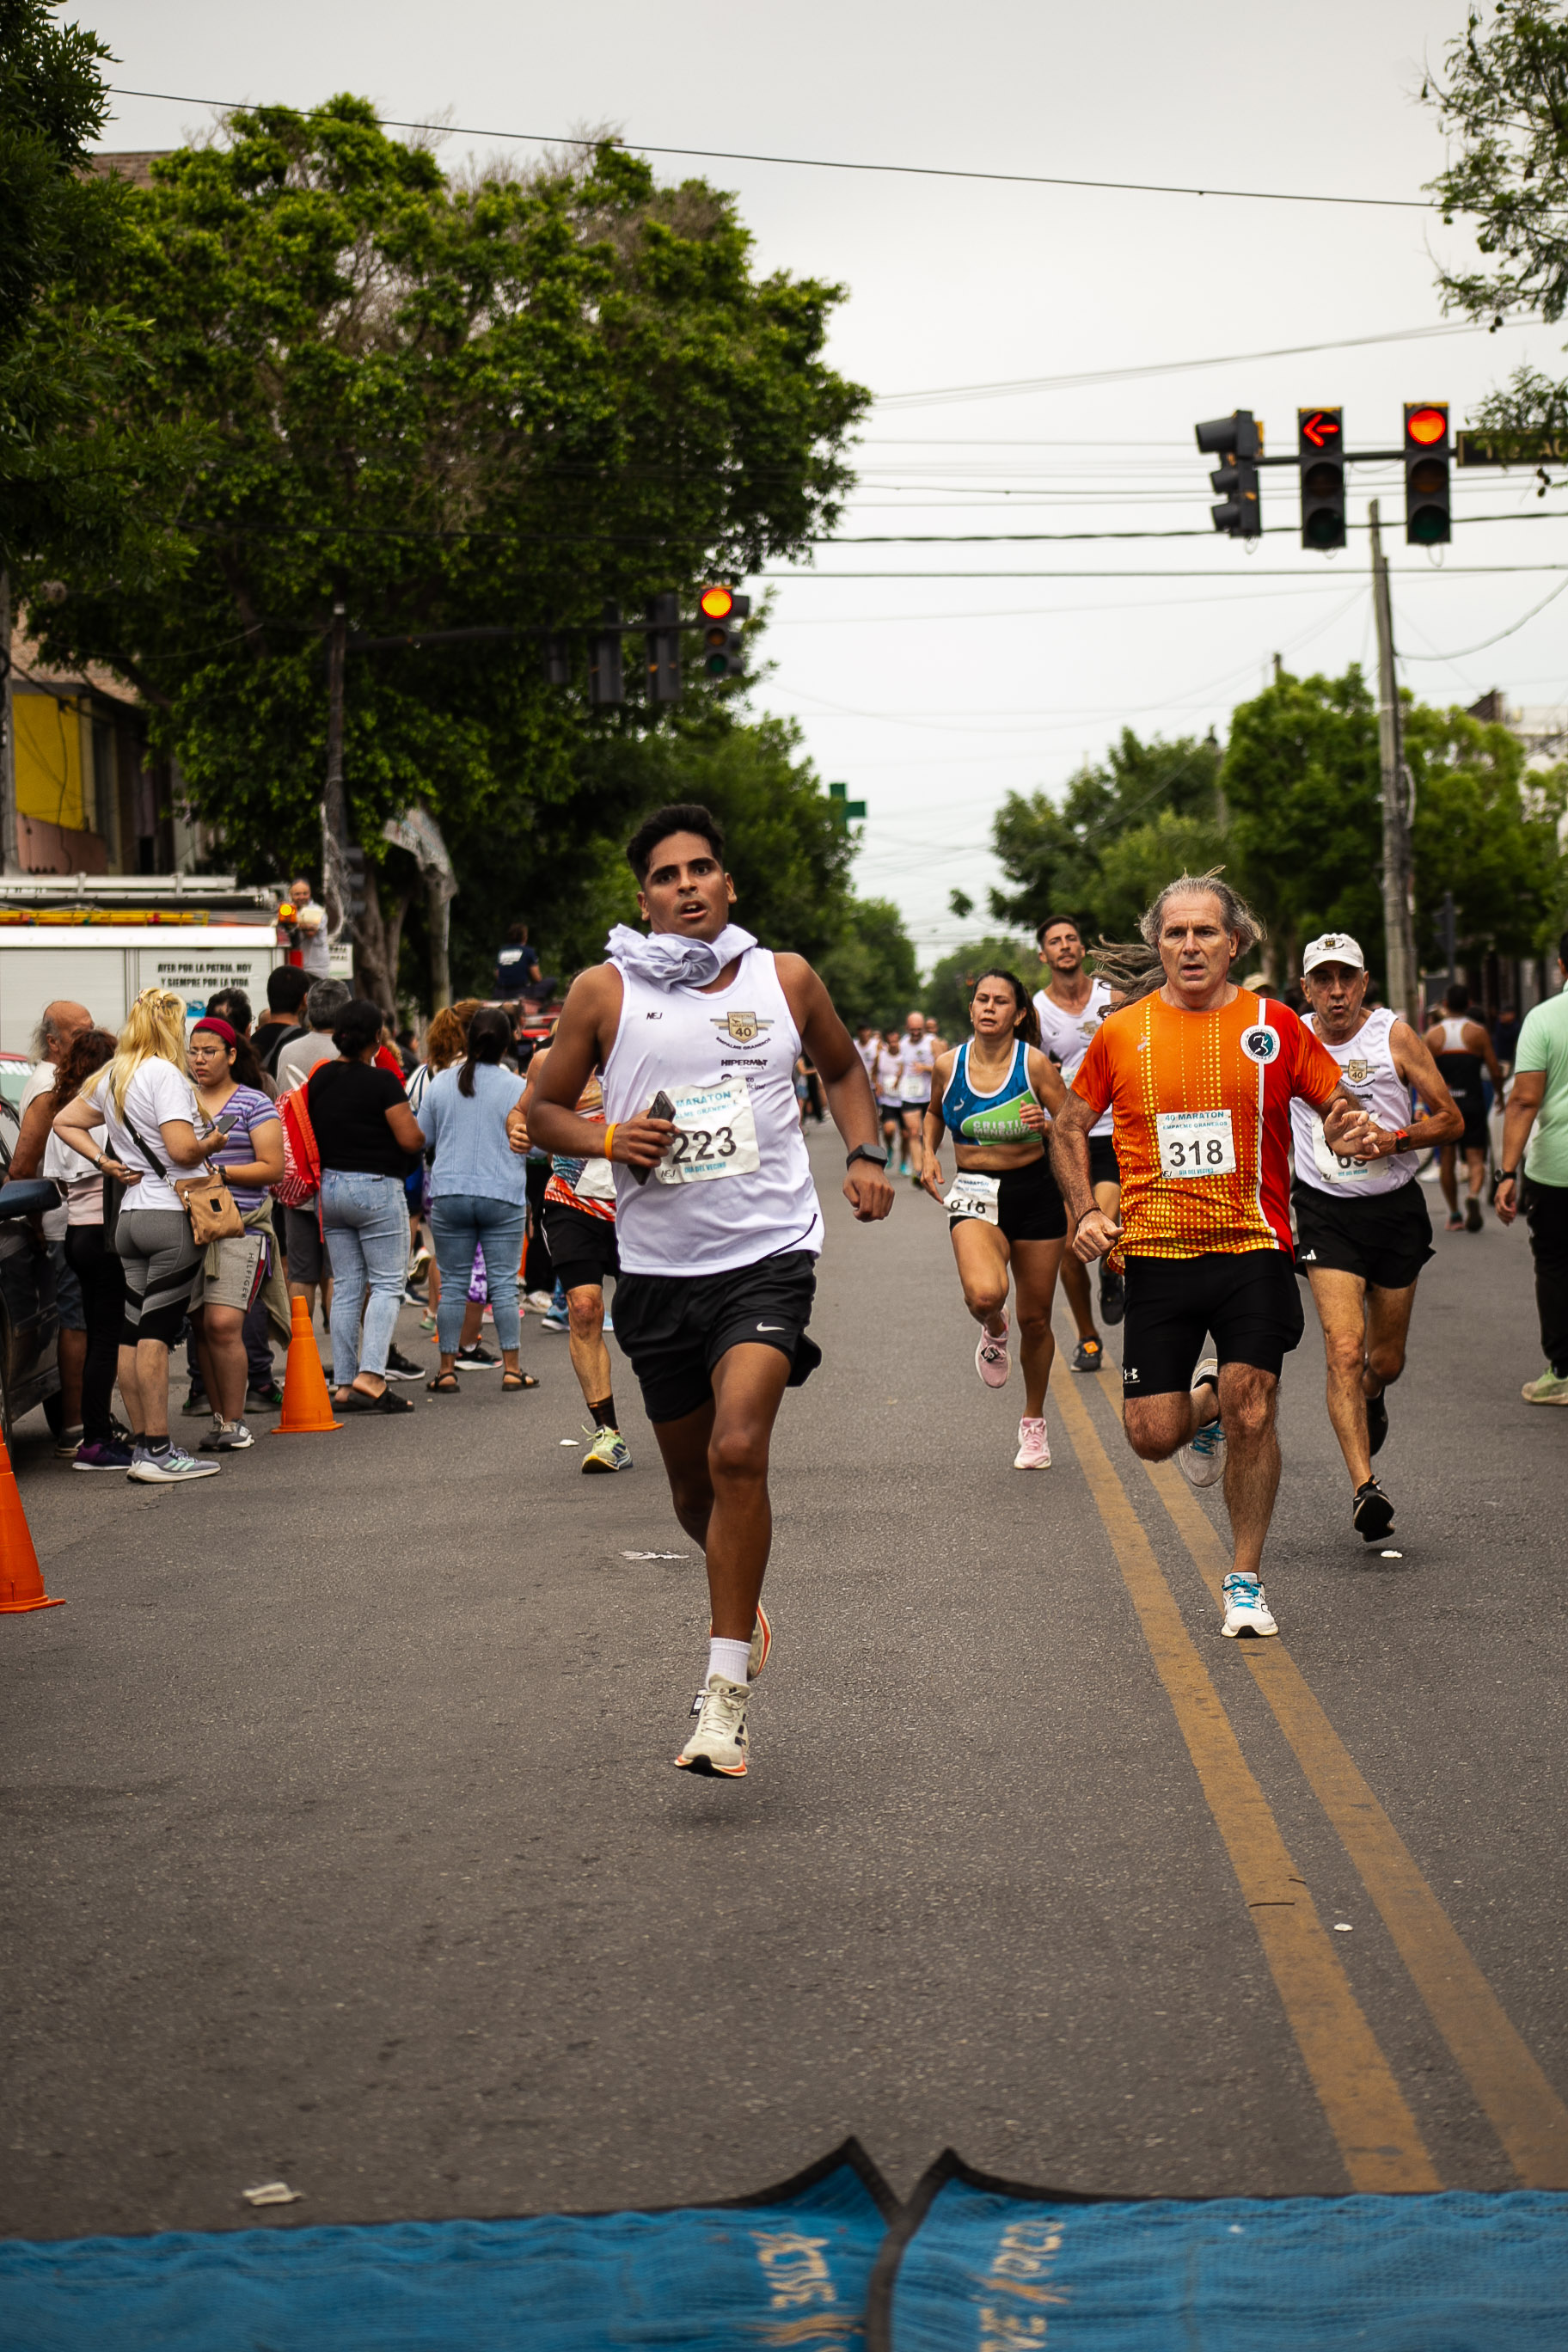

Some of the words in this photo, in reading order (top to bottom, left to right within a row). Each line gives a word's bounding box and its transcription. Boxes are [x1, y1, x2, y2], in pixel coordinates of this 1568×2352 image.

[158, 963, 175, 973] AYER
[178, 963, 193, 973] POR
[195, 963, 204, 973] LA
[236, 963, 252, 973] HOY
[161, 978, 166, 987] Y
[168, 978, 200, 988] SIEMPRE
[203, 978, 217, 988] POR
[220, 978, 228, 987] LA
[230, 978, 249, 988] VIDA
[735, 1027, 752, 1037] 40
[716, 1037, 742, 1050] EMPALME
[743, 1038, 771, 1050] GRANEROS
[676, 1090, 732, 1107] MARATON
[1178, 1112, 1224, 1121] MARATON
[672, 1126, 737, 1165] 223
[1169, 1139, 1223, 1167] 318
[661, 1169, 676, 1178] NEJ
[242, 1253, 254, 1302] HILFIGER
